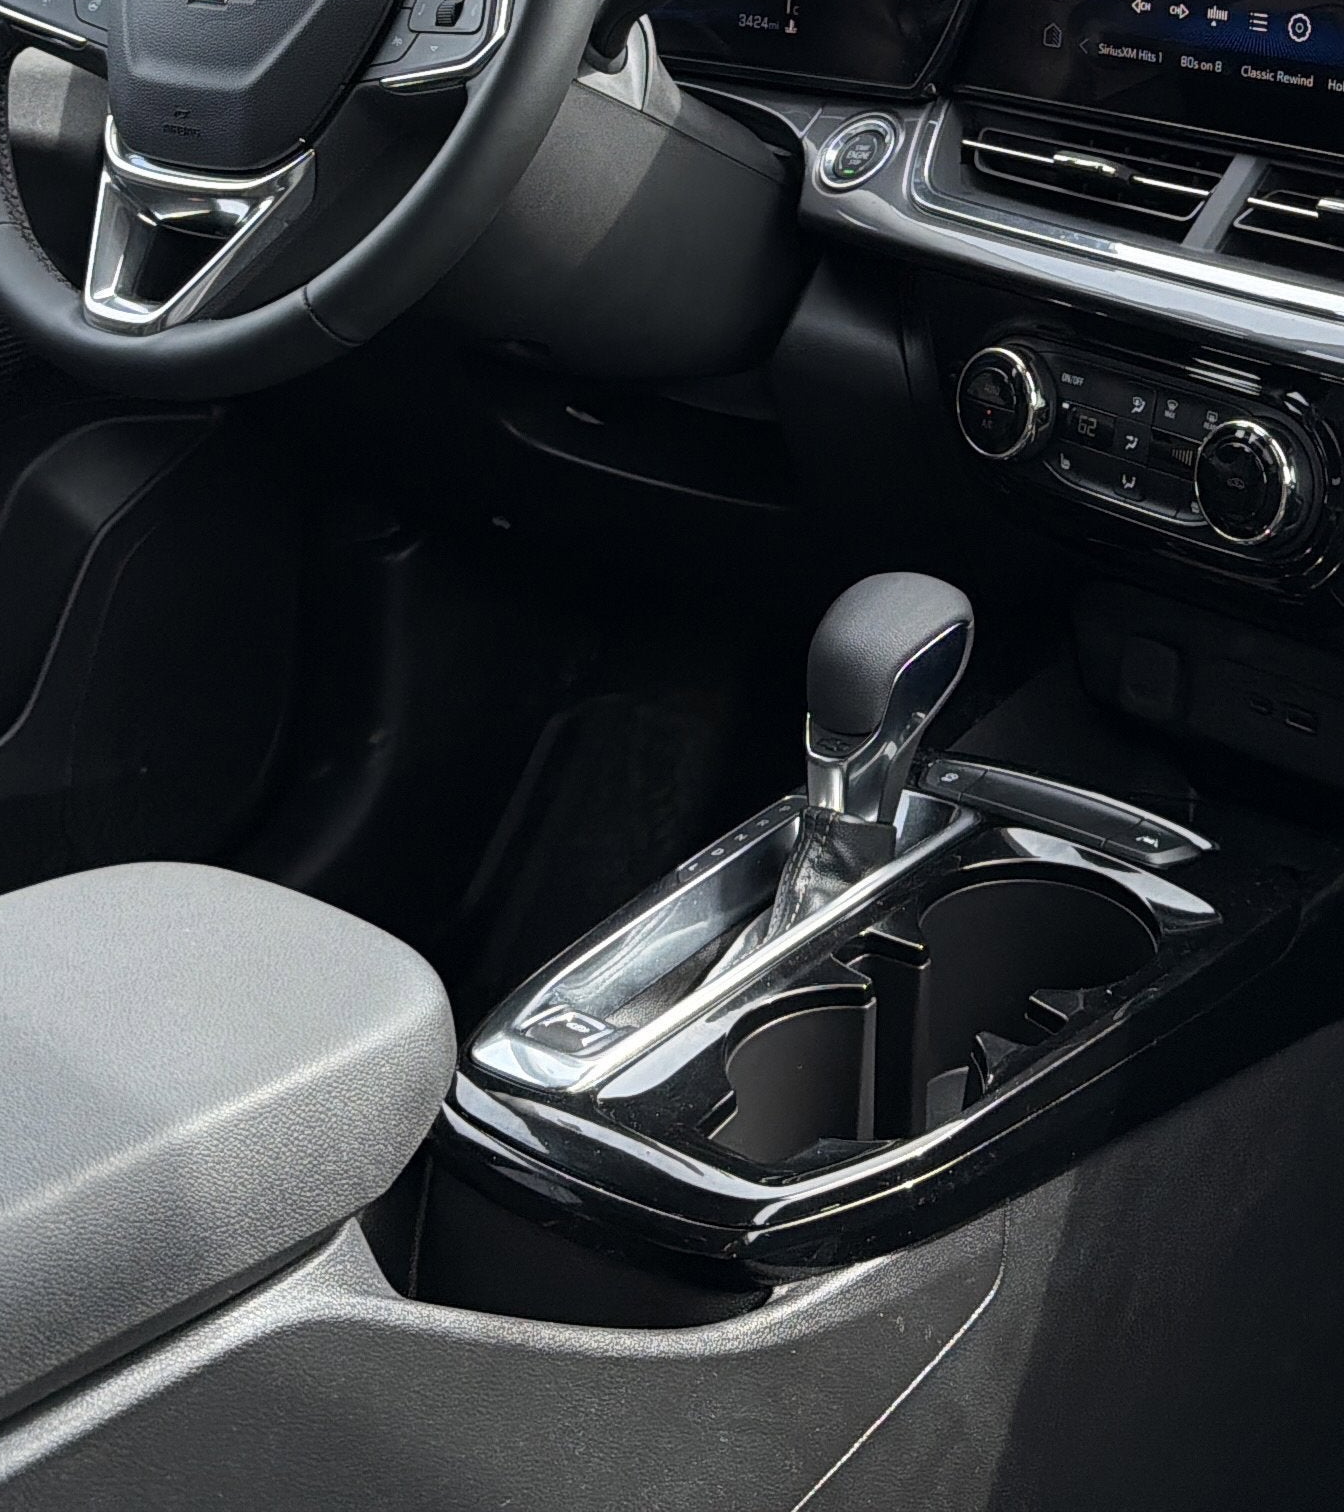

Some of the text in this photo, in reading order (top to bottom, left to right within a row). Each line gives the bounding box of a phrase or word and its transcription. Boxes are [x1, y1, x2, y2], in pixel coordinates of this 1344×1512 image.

[1141, 1, 1152, 11] CH
[1169, 5, 1180, 16] CH
[1098, 43, 1163, 63] SiriusXM Hits 1
[1180, 55, 1223, 73] 80s on 8
[1240, 65, 1314, 88] Classic Rewind
[1061, 372, 1085, 386] ON/OFF
[1077, 414, 1097, 437] 62
